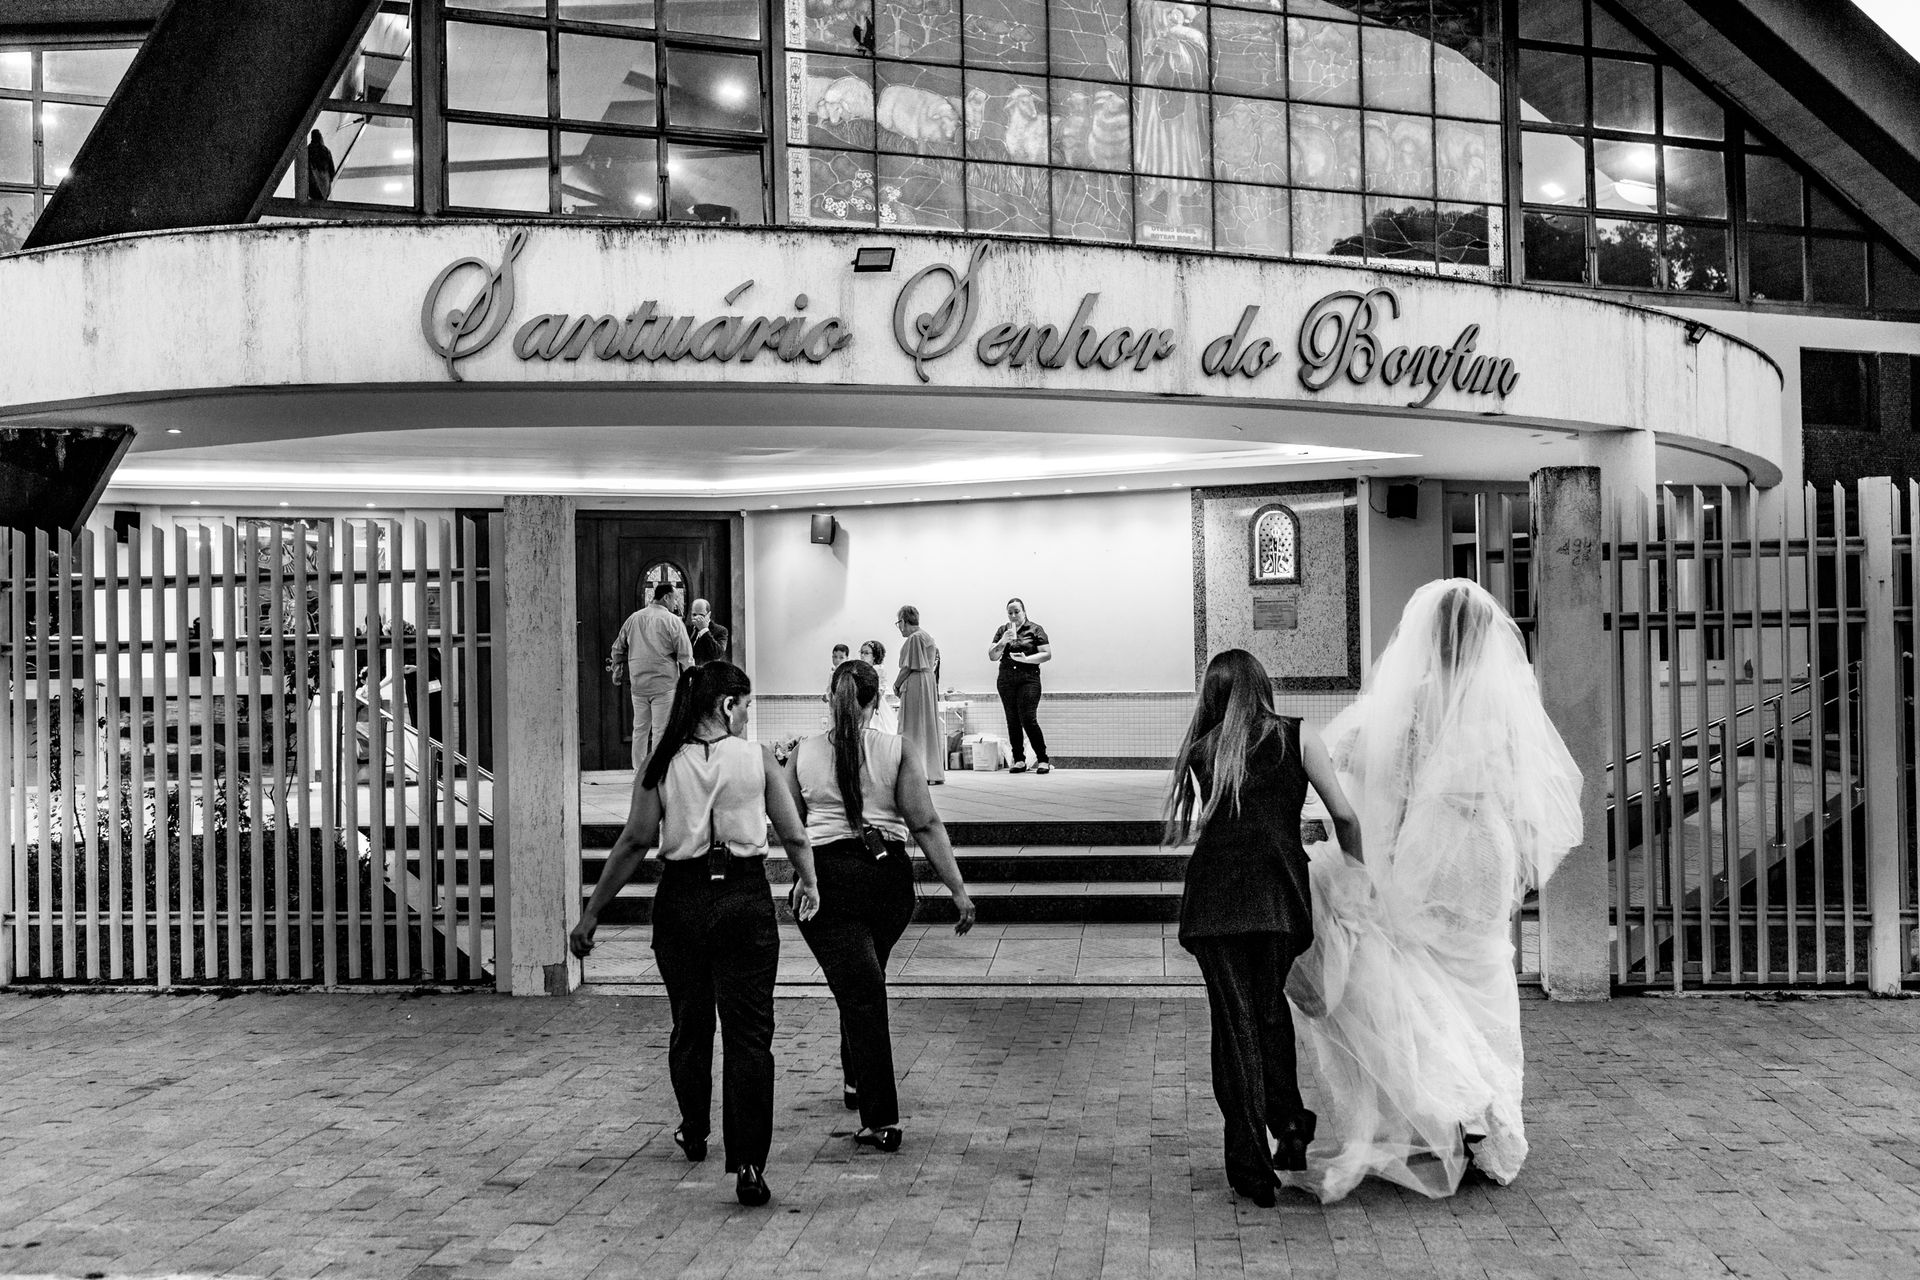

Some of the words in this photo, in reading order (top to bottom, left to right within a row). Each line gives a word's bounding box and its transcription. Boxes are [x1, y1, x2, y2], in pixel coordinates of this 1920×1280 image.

[421, 226, 853, 382] Santuário
[893, 239, 1176, 381] Senhor
[1202, 305, 1281, 378] do
[1299, 288, 1520, 408] Bonfim
